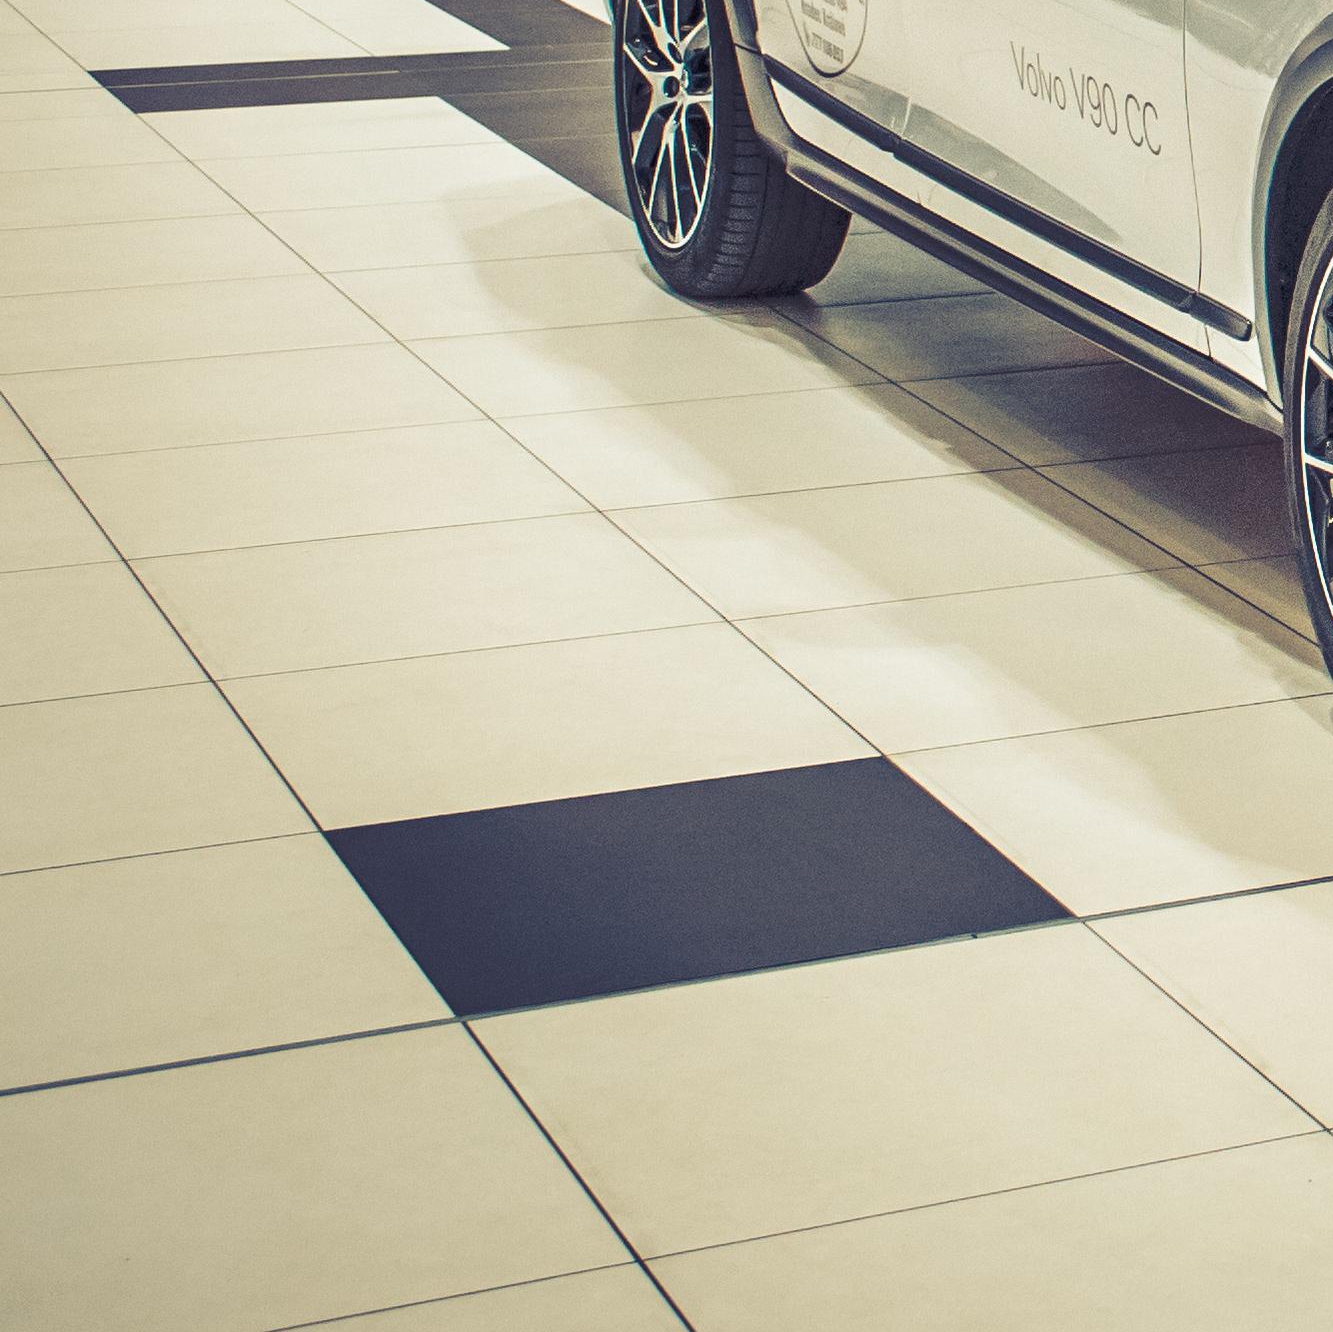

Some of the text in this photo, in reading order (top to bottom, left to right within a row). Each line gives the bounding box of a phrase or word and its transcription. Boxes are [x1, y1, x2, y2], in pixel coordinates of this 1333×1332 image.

[1010, 40, 1162, 156] Volvo V90 CC
